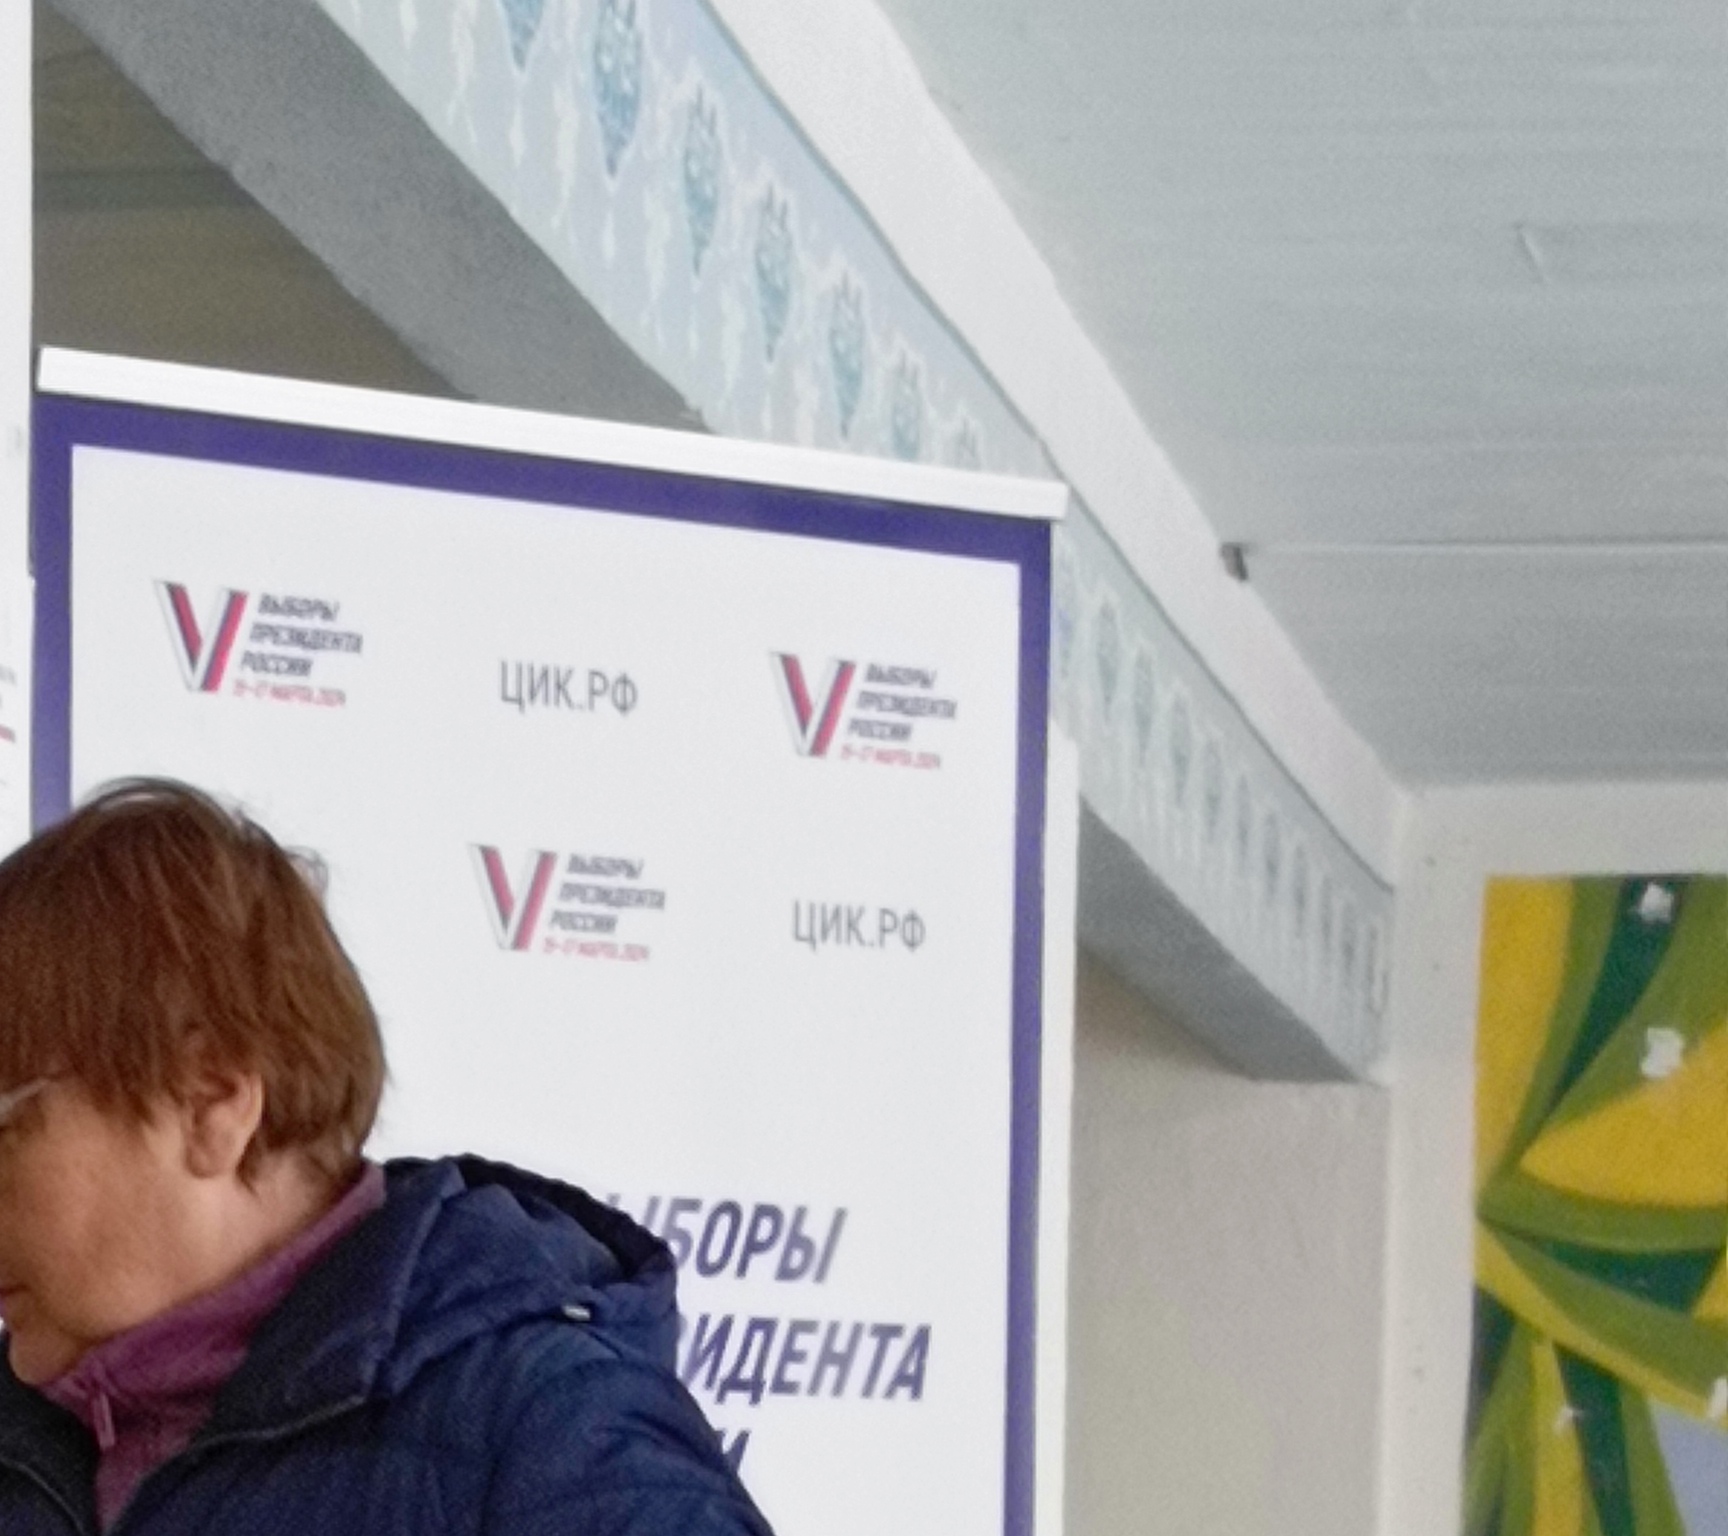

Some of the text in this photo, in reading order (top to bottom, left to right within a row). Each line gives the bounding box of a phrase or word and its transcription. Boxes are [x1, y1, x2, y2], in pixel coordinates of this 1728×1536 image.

[500, 659, 639, 717] ЦИК.РФ
[792, 899, 927, 953] ЦИК.РФ
[643, 1195, 849, 1285] БОРЫ
[682, 1313, 932, 1406] ИДЕНТА
